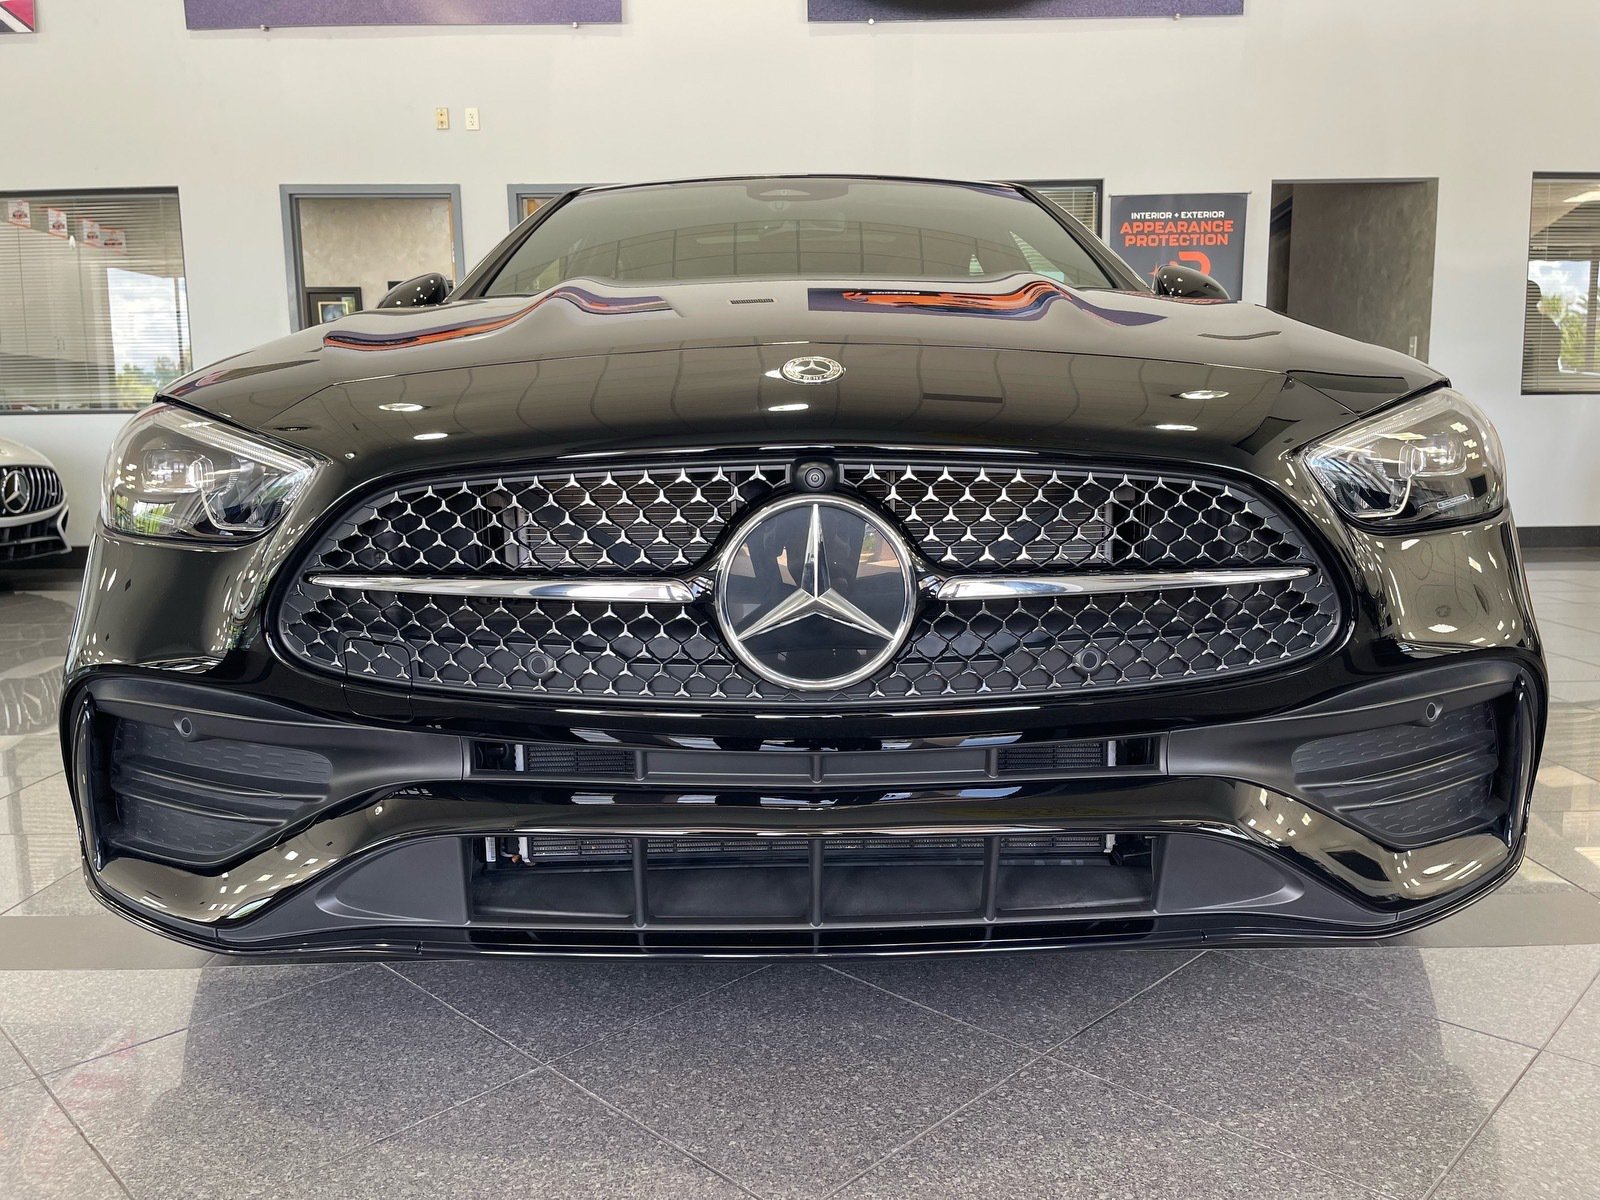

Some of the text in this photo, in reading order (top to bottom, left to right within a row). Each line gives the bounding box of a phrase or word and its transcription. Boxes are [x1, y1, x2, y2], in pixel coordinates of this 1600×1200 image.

[1131, 211, 1172, 219] INTERIOR
[1180, 210, 1225, 219] EXTERIOR
[1120, 220, 1234, 234] APPEARANCE
[1125, 233, 1229, 247] PROTECTION
